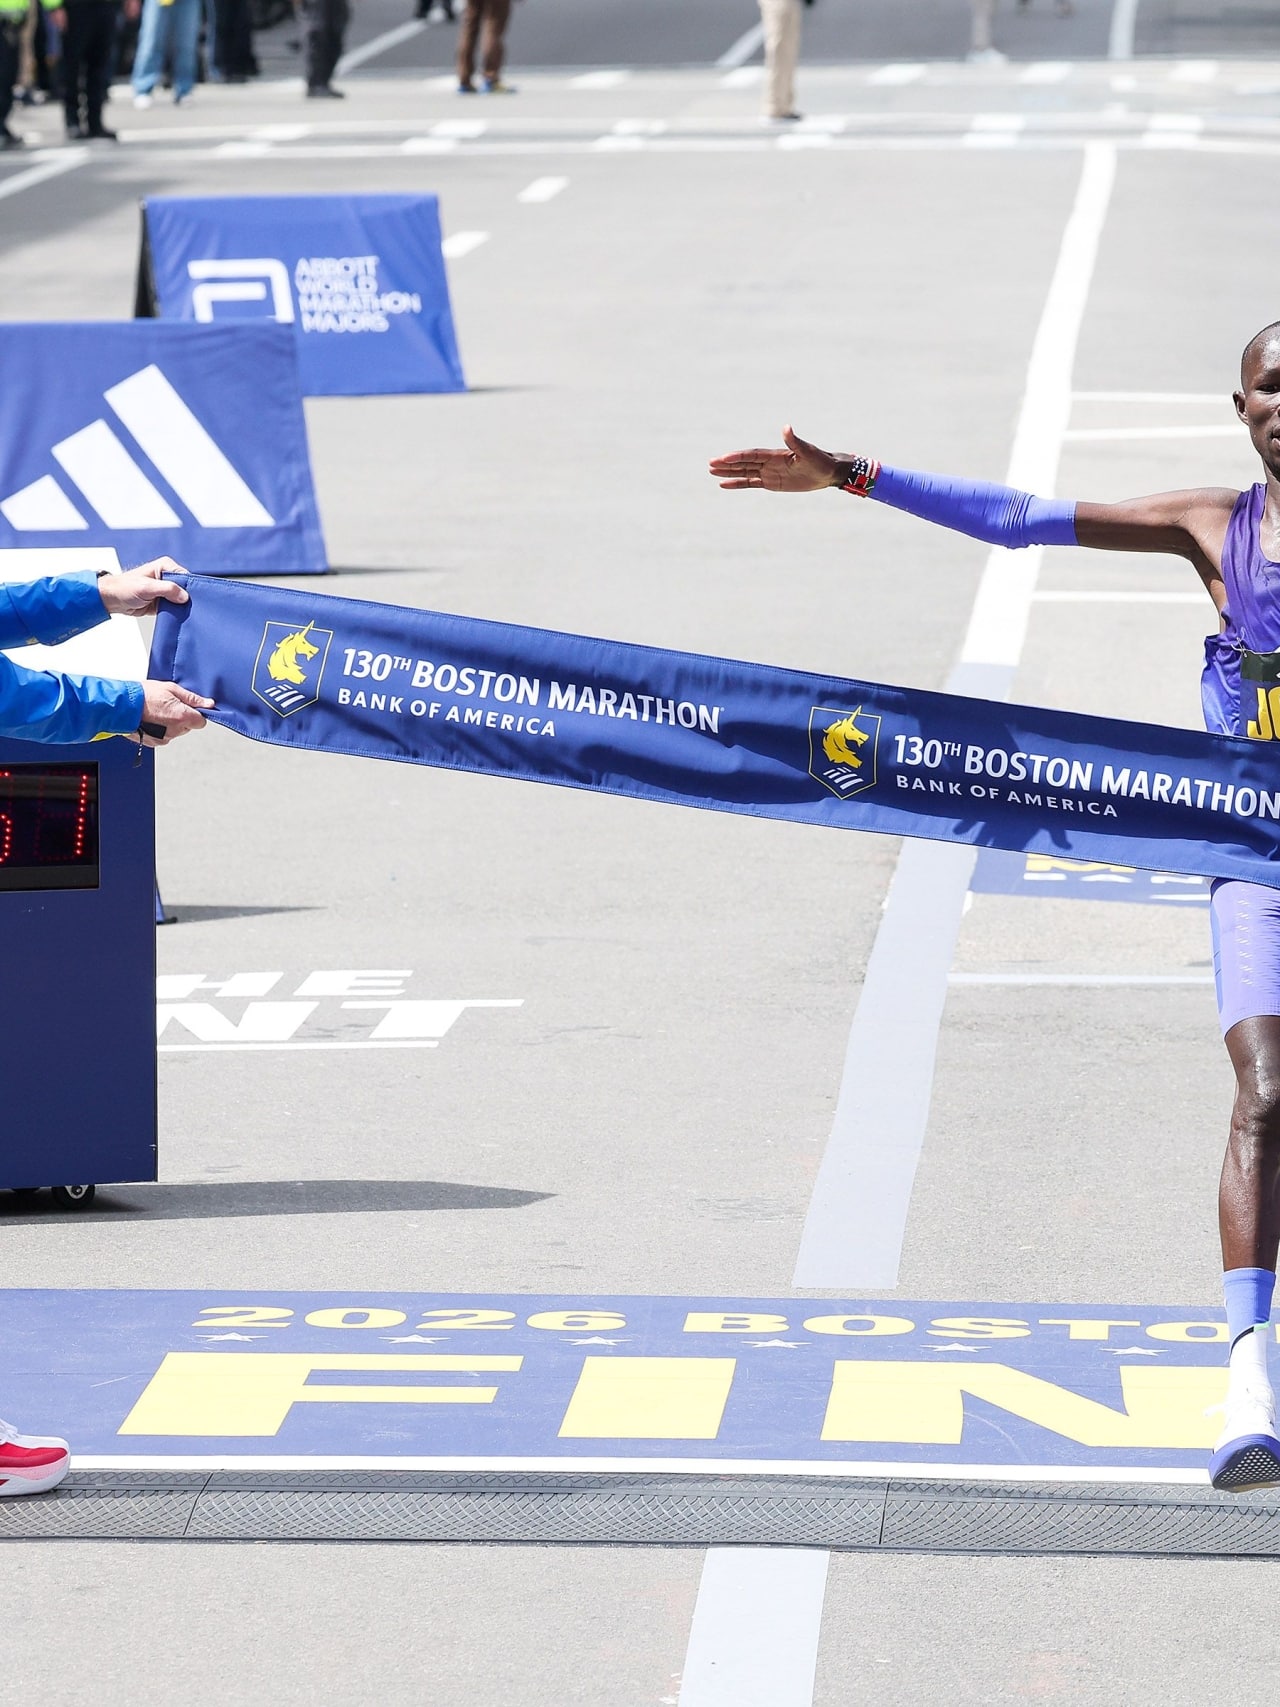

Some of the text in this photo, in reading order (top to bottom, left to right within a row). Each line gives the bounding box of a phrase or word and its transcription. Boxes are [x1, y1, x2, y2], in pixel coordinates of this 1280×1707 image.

[295, 256, 380, 277] ABBOTT
[296, 275, 378, 295] WORLD
[299, 291, 422, 314] MARATHON
[302, 311, 389, 333] MAJORS
[344, 649, 719, 733] 130TH BOSTON MARATHON
[339, 688, 554, 736] BANK OF AMERICA
[895, 735, 1280, 818] 130TH BOSTON MARATHON
[897, 775, 1117, 817] BANK OF AMERICA
[157, 969, 413, 998] HE
[156, 999, 525, 1041] NT
[191, 1306, 628, 1331] 2026
